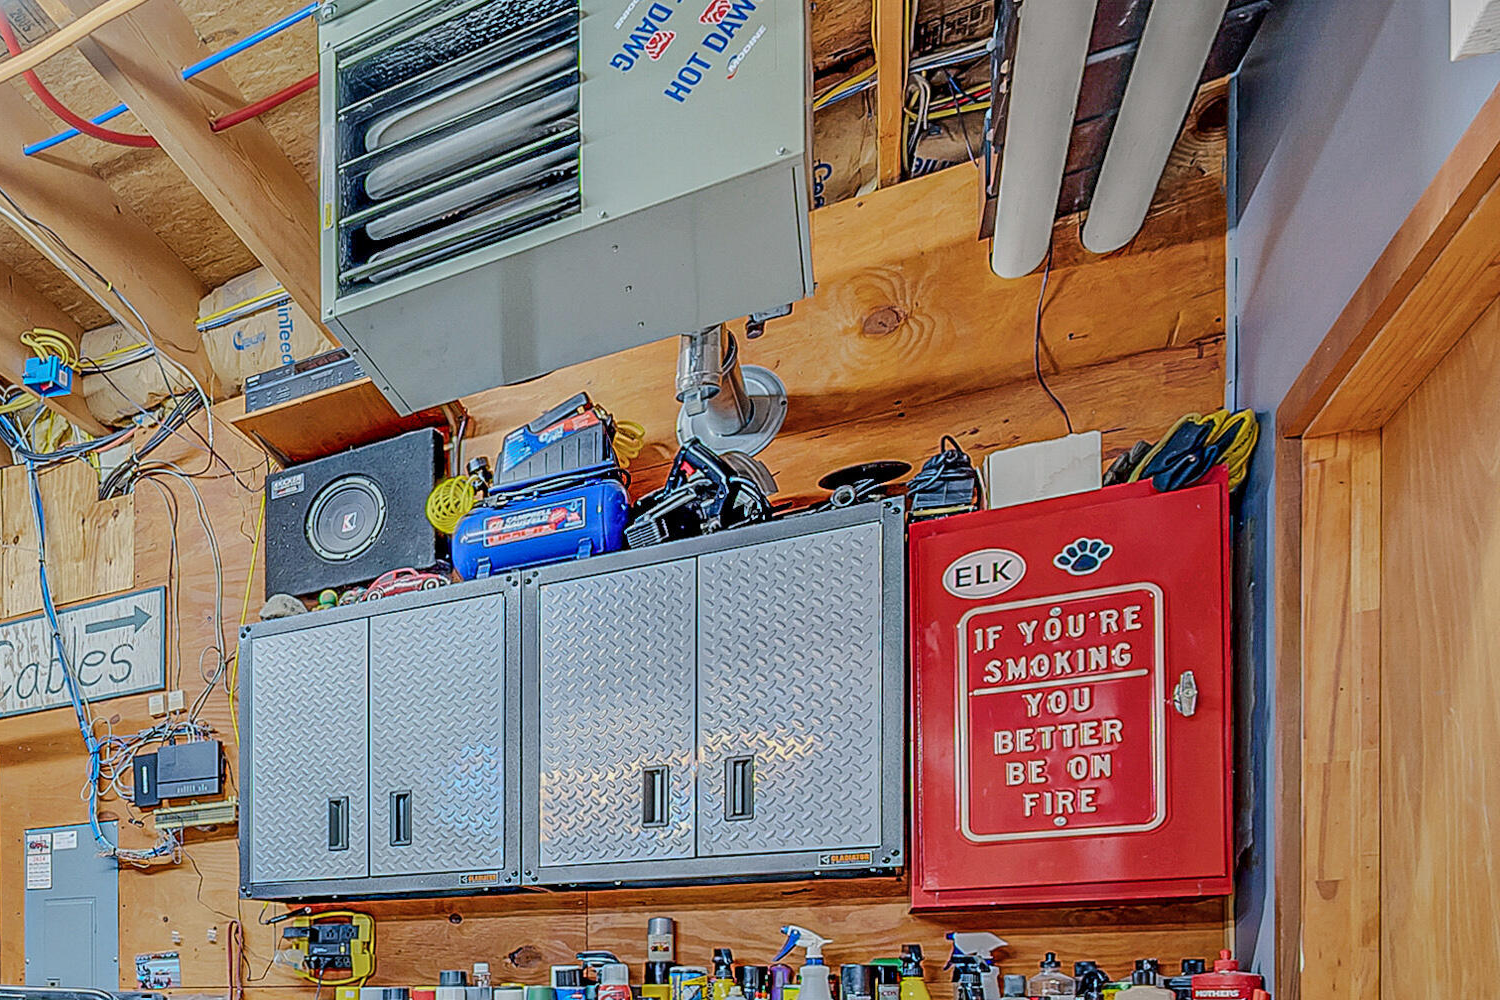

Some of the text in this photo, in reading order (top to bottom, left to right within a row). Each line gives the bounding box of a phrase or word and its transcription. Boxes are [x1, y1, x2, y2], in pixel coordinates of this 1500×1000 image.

[609, 3, 674, 71] DAWG
[664, 0, 760, 102] HOT DAW
[728, 24, 767, 72] MODINE
[954, 559, 1013, 589] ELK
[973, 605, 1143, 653] IF YOU'RE
[984, 643, 1133, 684] SMOKING
[1022, 687, 1092, 717] YOU
[994, 719, 1124, 756] BETTER
[1006, 754, 1113, 787] BE ON
[1022, 789, 1099, 817] FIRE
